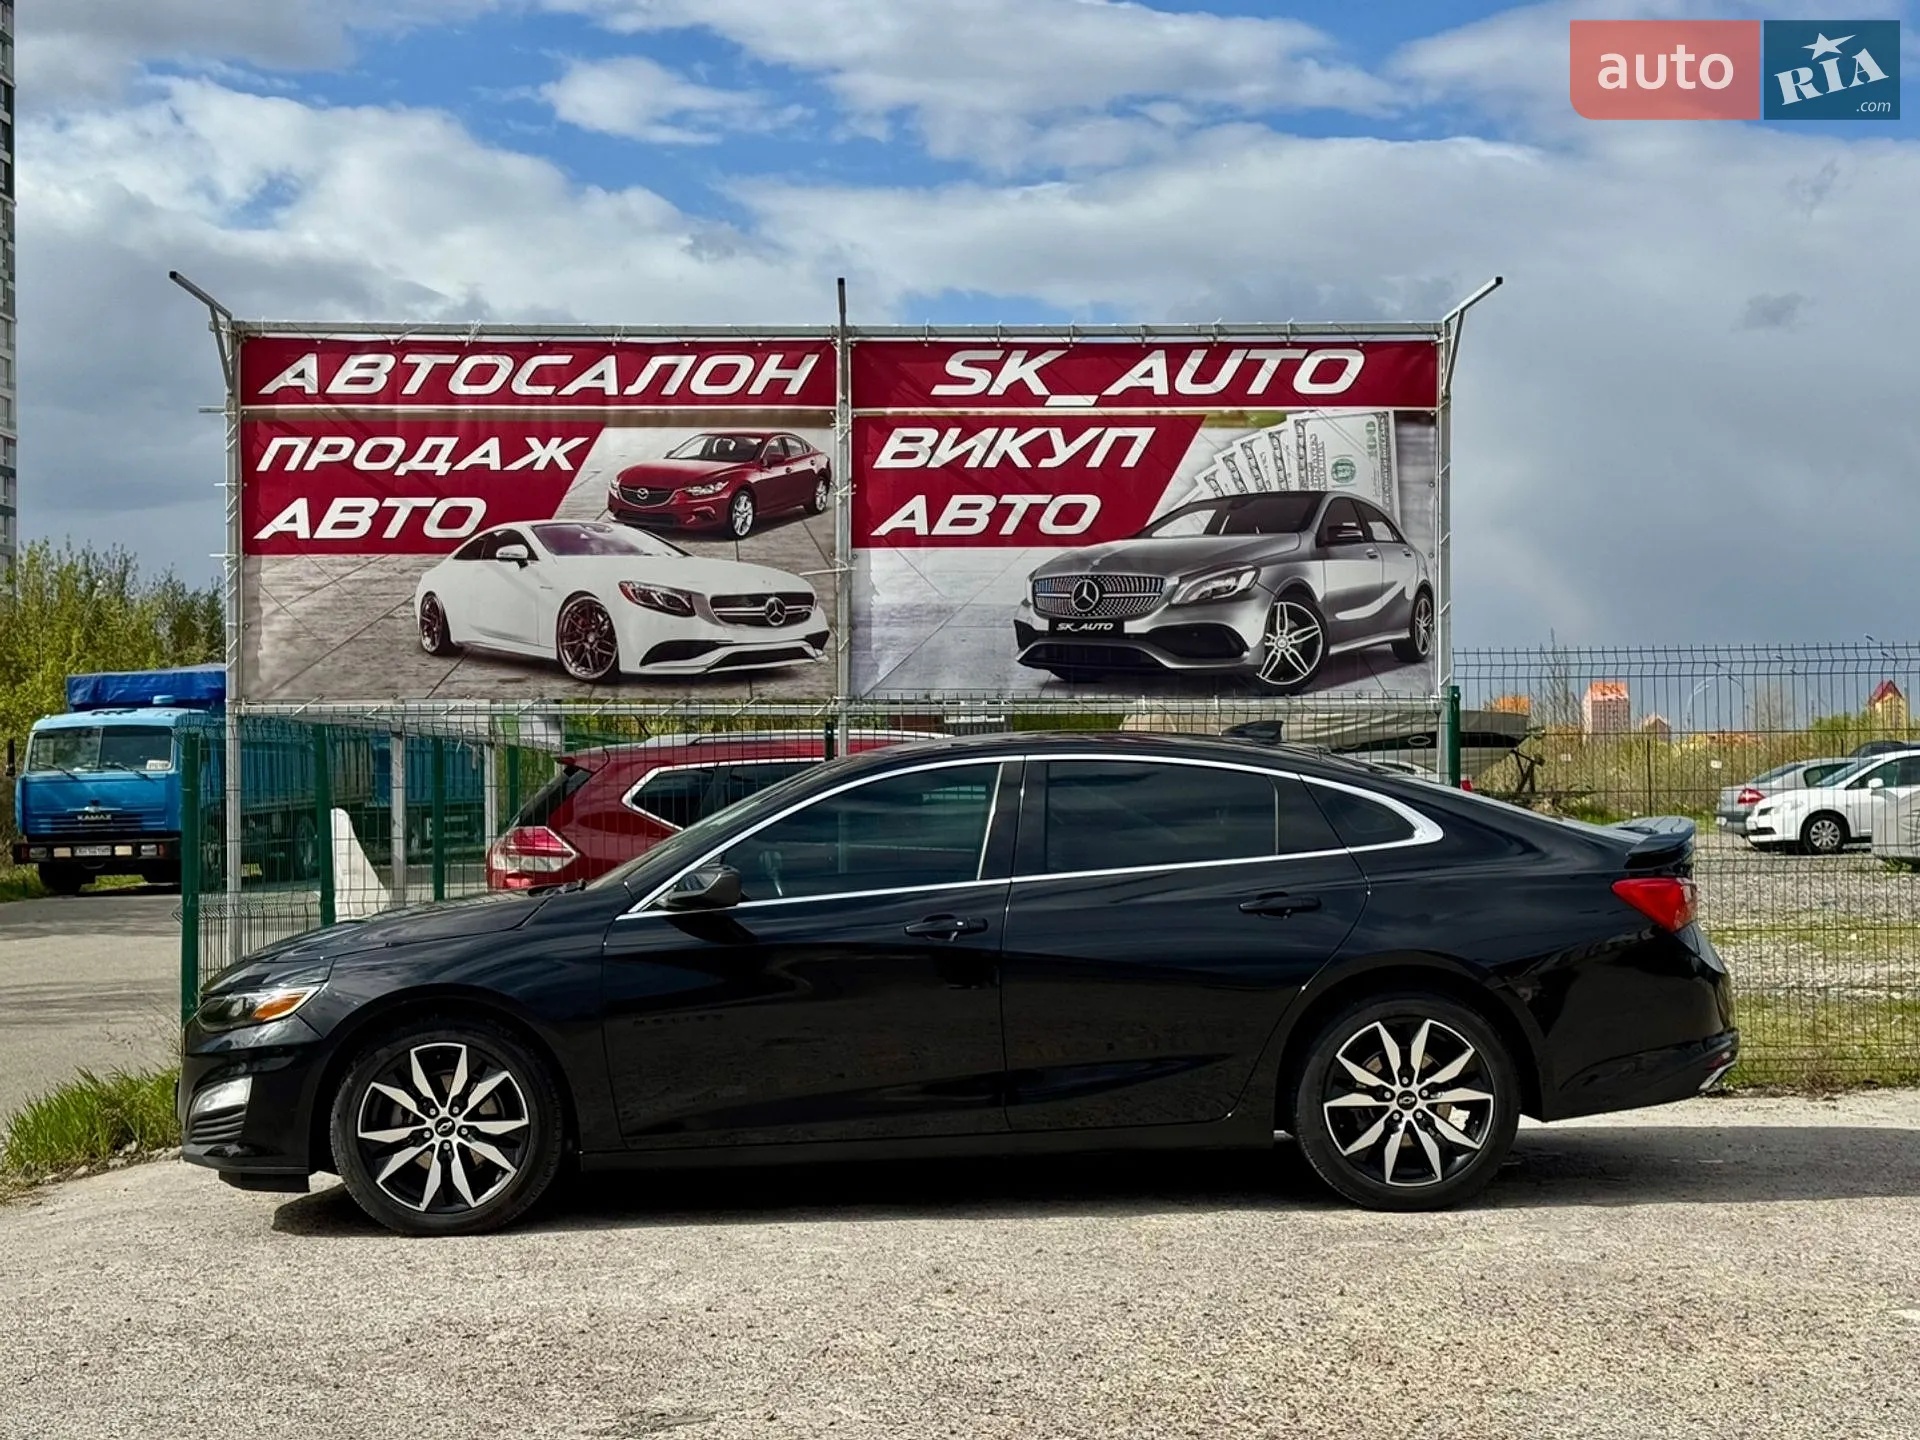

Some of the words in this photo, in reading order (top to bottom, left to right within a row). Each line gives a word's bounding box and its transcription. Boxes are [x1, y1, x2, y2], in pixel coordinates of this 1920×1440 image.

[258, 353, 820, 396] АВТОСАЛОН
[930, 348, 1366, 407] SK_AUTO
[256, 436, 589, 476] ПРОДАЖ
[872, 427, 1156, 469] ВИКУП
[253, 497, 487, 541] АВТО
[870, 494, 1102, 536] АВТО
[1056, 622, 1114, 632] SK_AUTO
